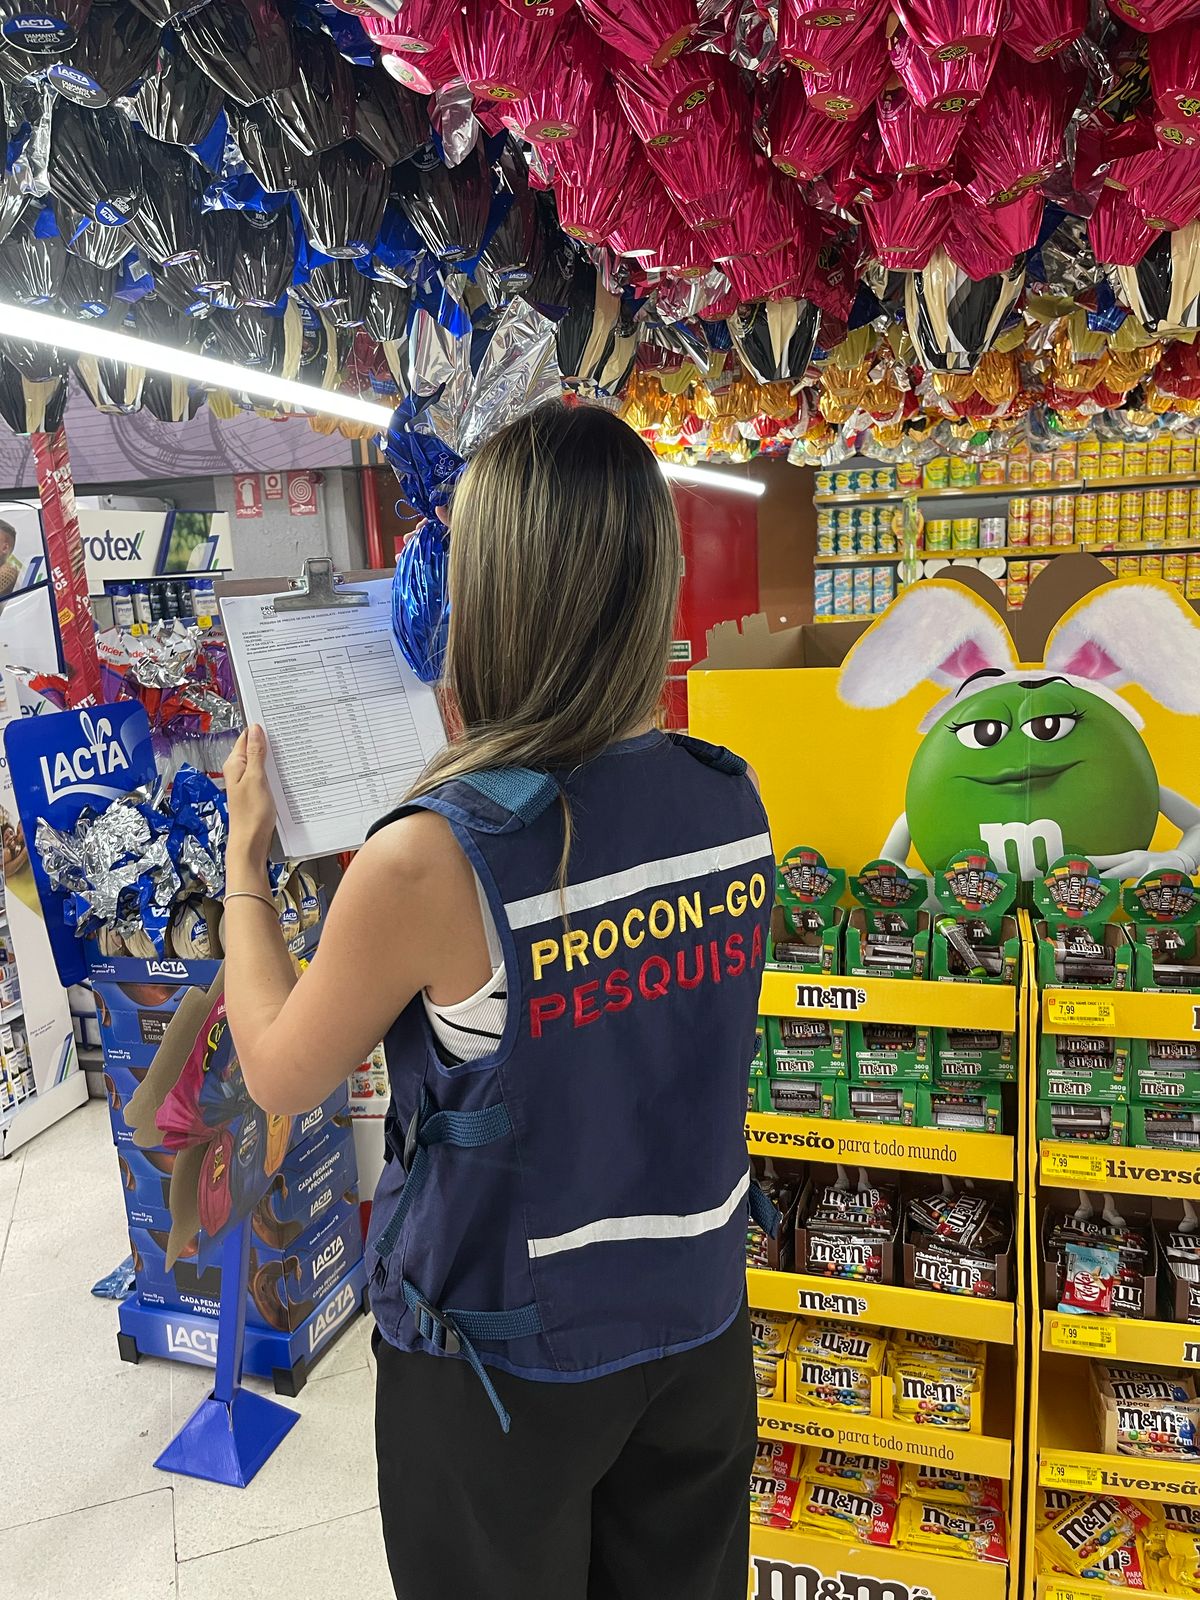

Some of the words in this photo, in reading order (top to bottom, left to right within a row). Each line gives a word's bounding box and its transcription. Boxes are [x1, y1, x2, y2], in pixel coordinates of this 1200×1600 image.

[15, 20, 55, 28] LACTA
[57, 66, 91, 86] LACTA
[83, 529, 145, 561] rotex
[40, 740, 129, 805] LACTA
[530, 872, 766, 981] PROCON-GO
[288, 935, 305, 953] ACTA
[146, 961, 189, 978] LACTA
[528, 923, 763, 1038] PESQUISA
[1059, 1005, 1075, 1015] 7,99
[301, 1106, 324, 1135] LACTA
[744, 1124, 835, 1150] iversão
[838, 1137, 870, 1155] para
[873, 1138, 905, 1157] todo
[908, 1144, 958, 1163] mundo
[1052, 1157, 1068, 1168] 7,99
[298, 1176, 313, 1192] CADA
[310, 1188, 333, 1217] LACTA
[312, 1235, 345, 1280] LACTA
[180, 1295, 200, 1305] CADA
[200, 1298, 221, 1308] PEDAC
[193, 1305, 221, 1316] APROXI
[308, 1283, 356, 1353] LACTA
[166, 1324, 218, 1360] LACT
[757, 1415, 835, 1440] versão
[838, 1429, 870, 1446] para
[872, 1433, 903, 1452] todo
[906, 1441, 955, 1461] mundo
[873, 1519, 890, 1529] PARA
